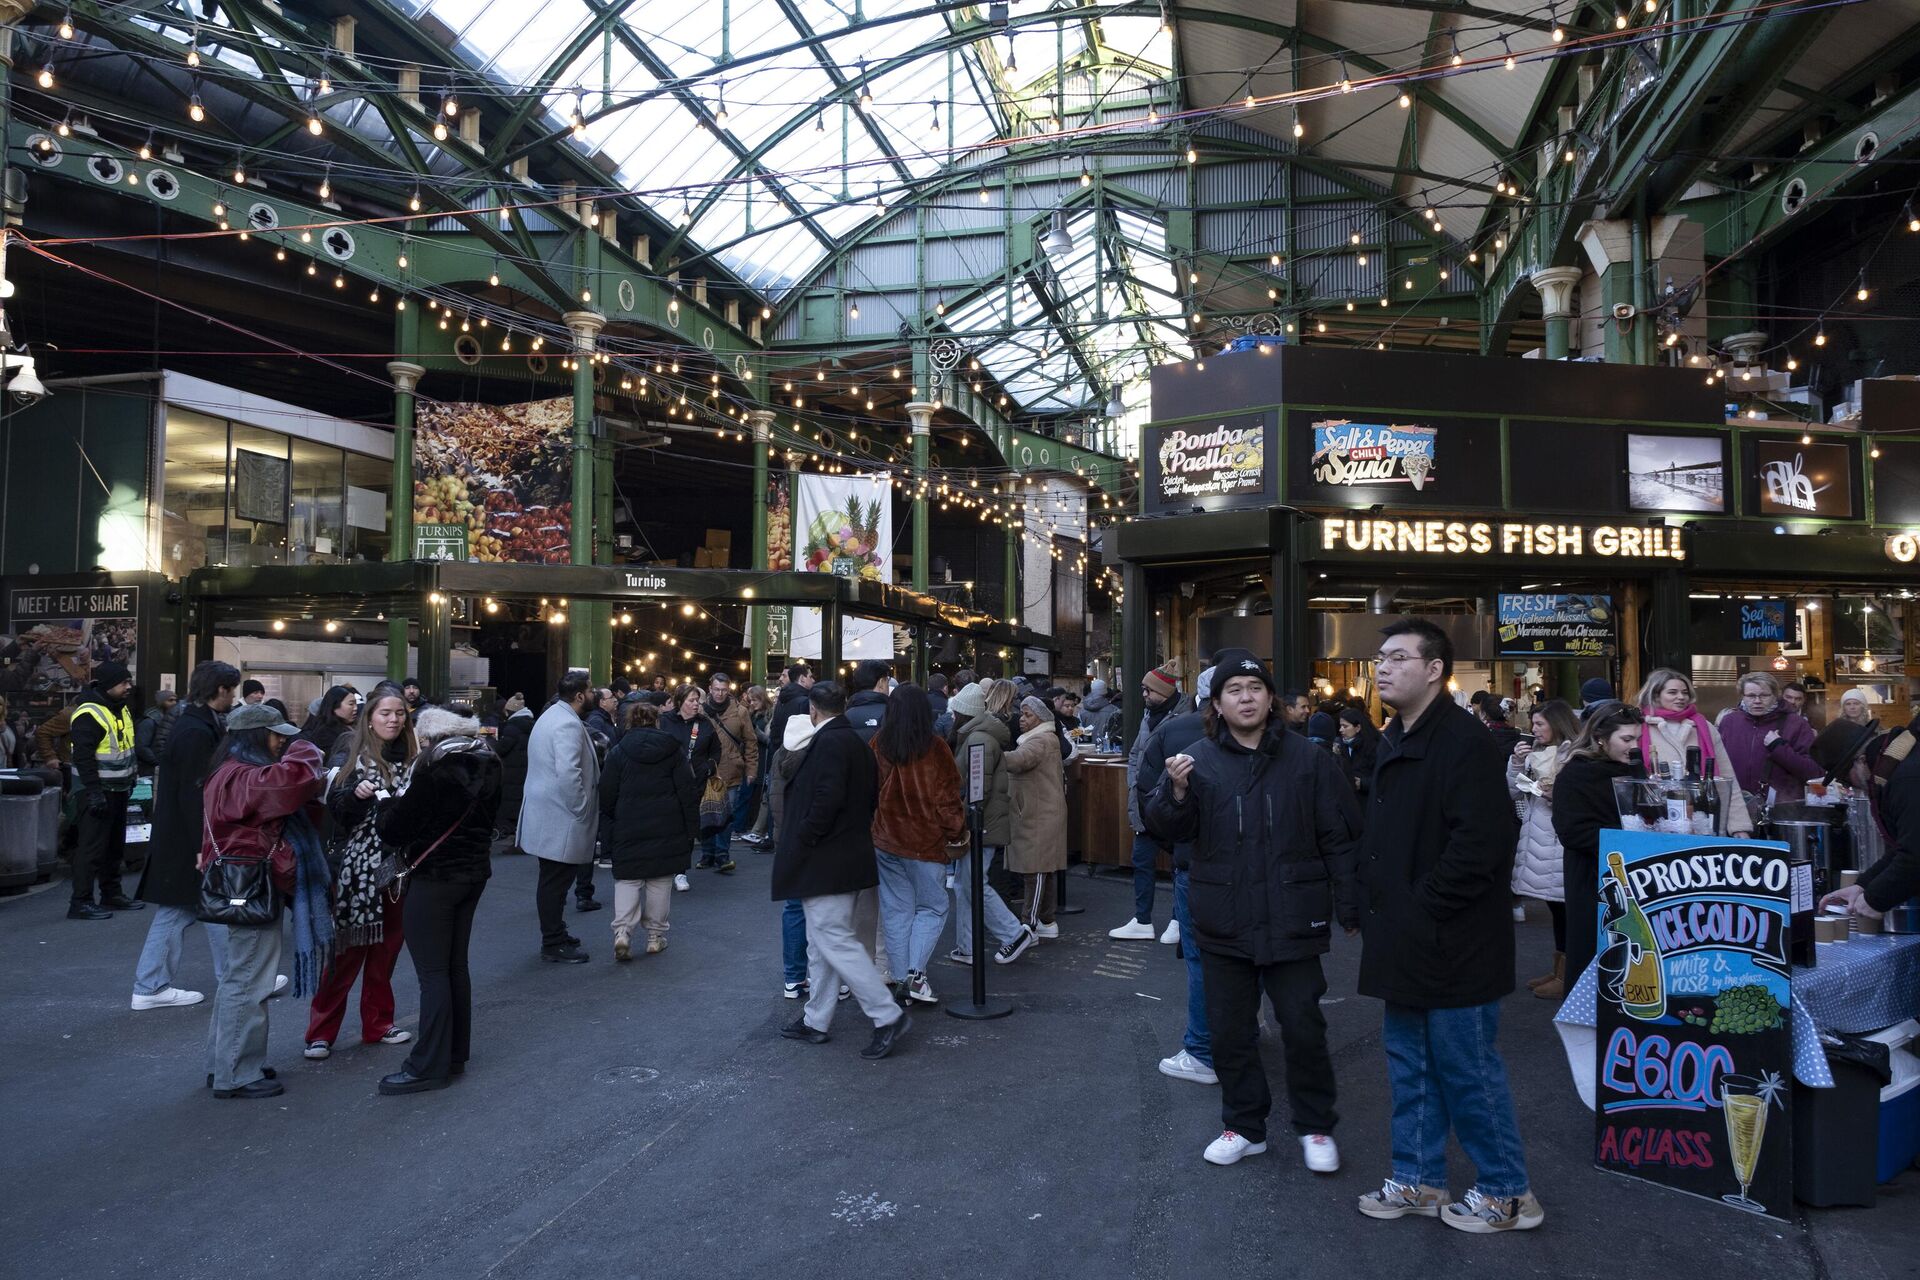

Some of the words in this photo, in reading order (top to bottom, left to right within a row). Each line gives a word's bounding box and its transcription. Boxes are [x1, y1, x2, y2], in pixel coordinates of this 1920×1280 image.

[1170, 425, 1243, 458] Bomba
[1323, 427, 1361, 450] Salt
[1360, 429, 1381, 449] &
[1378, 430, 1431, 455] Pepper
[1169, 448, 1233, 474] Paella
[1314, 449, 1398, 486] Squid
[1220, 479, 1237, 493] Tiger
[417, 525, 463, 537] TURNIPS
[1323, 519, 1492, 553] FURNESS
[1503, 523, 1582, 555] FISH
[1593, 525, 1686, 560] GRILL
[625, 573, 666, 590] Turnips
[18, 596, 51, 614] MEET
[60, 595, 82, 612] EAT
[90, 594, 129, 612] SHARE
[1502, 594, 1557, 612] FRESH
[1501, 613, 1521, 625] Hand
[1521, 612, 1555, 624] Gathered
[1556, 609, 1589, 622] Mussels
[1741, 604, 1764, 622] Sea
[1743, 621, 1778, 639] Urchin
[1581, 637, 1603, 650] Frites
[1629, 853, 1788, 900] PROSECCO
[1670, 953, 1710, 977] white
[1713, 952, 1732, 972] &
[1626, 983, 1657, 1002] BRUT
[1712, 976, 1722, 990] by
[1620, 1125, 1714, 1168] GLASS
